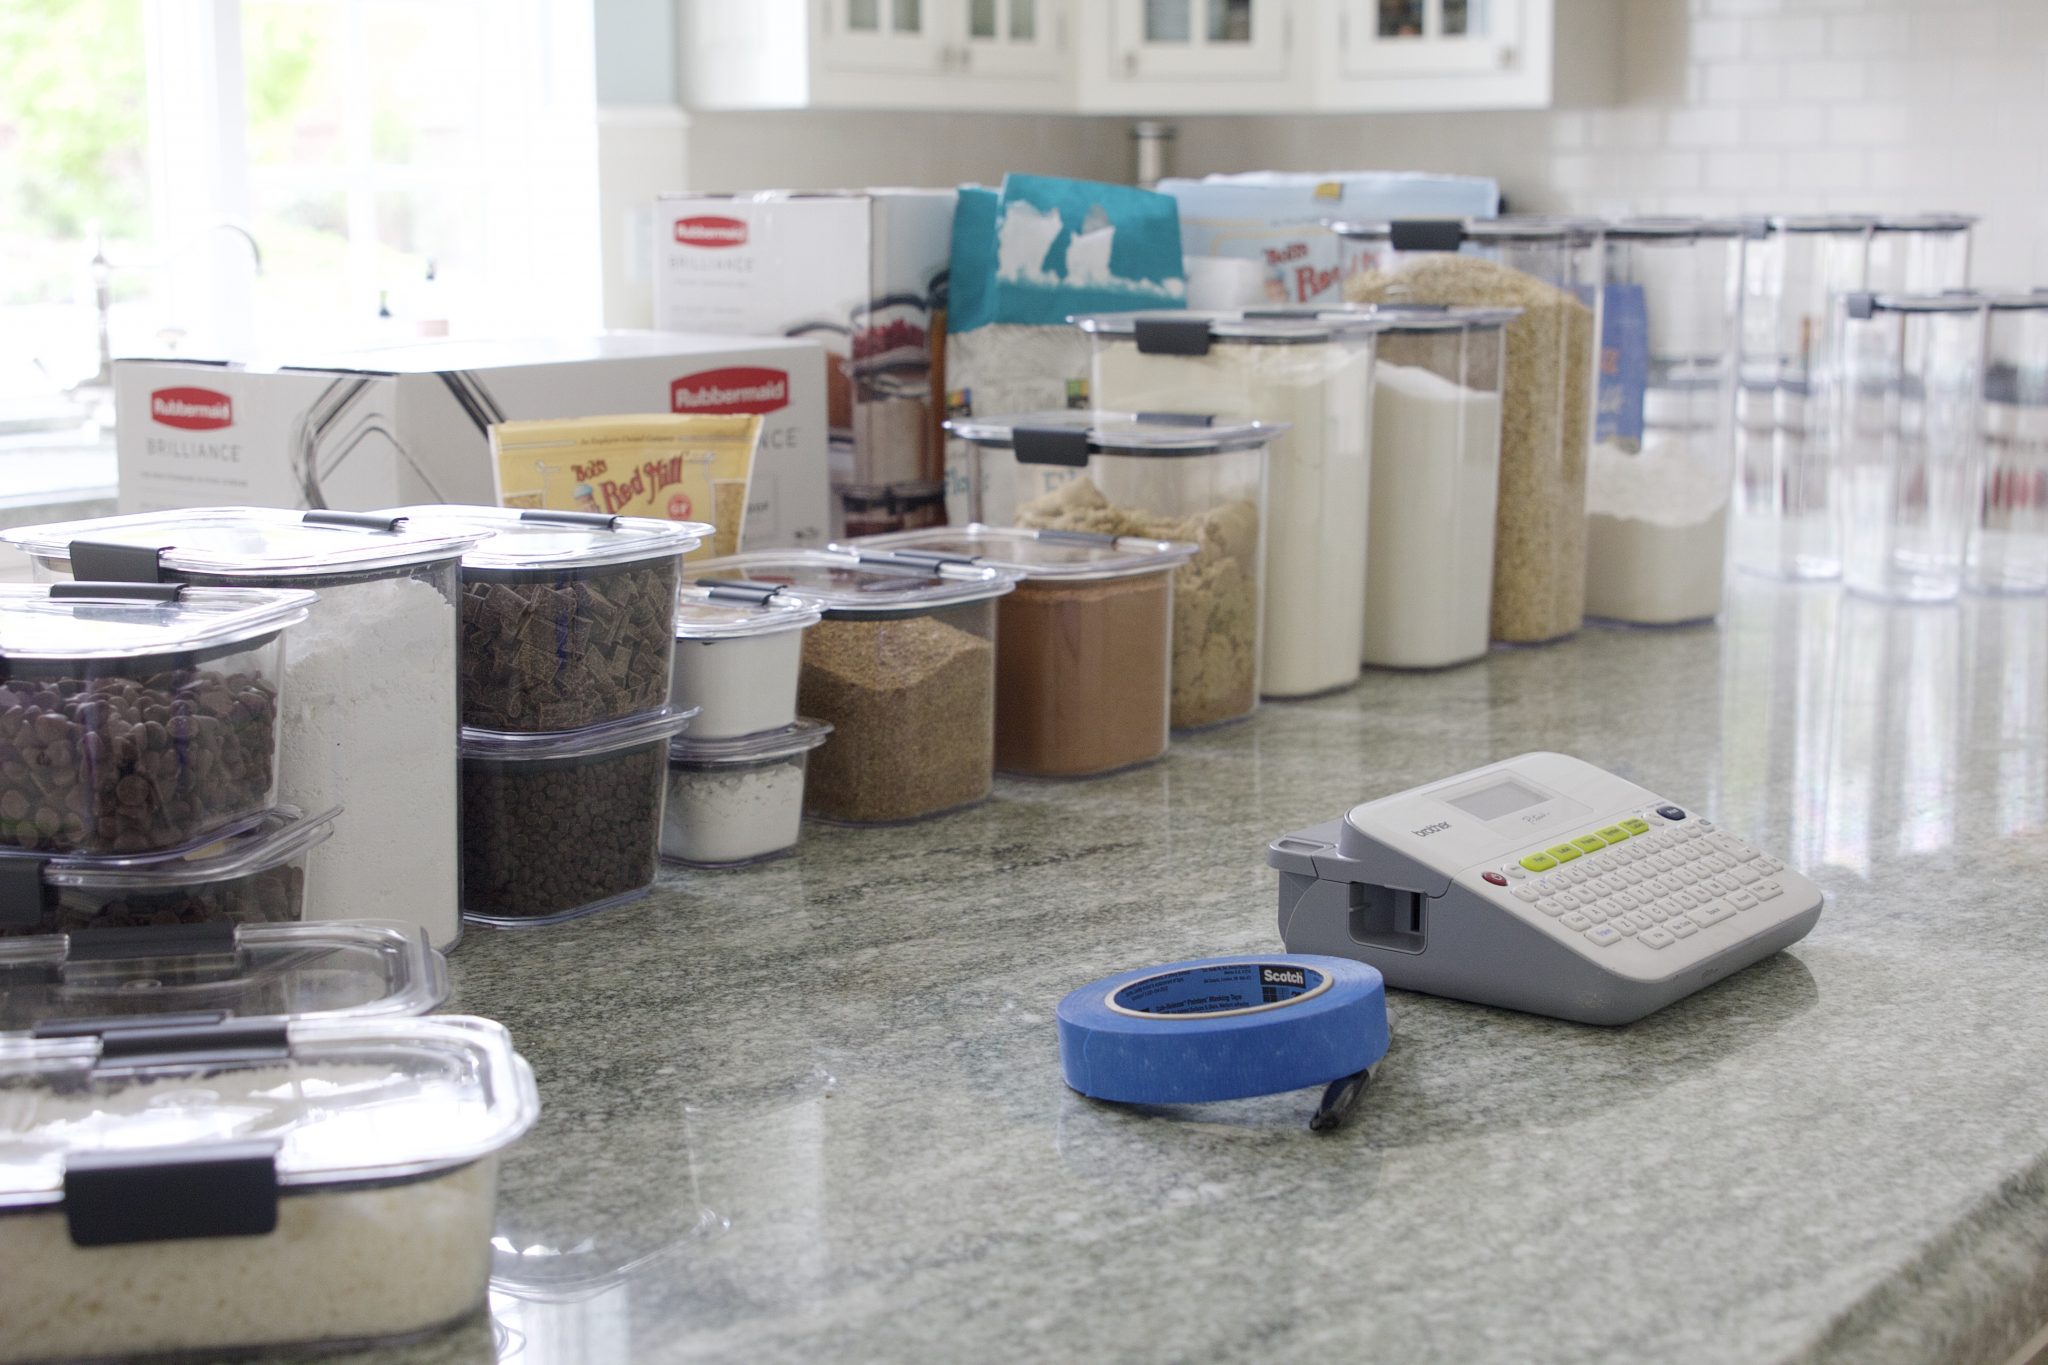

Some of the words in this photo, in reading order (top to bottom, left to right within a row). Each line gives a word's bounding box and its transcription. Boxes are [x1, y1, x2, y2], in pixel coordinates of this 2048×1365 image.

[674, 380, 786, 409] Rubbermaid
[154, 397, 230, 420] Rubbermaid
[599, 465, 645, 515] Red
[643, 453, 683, 505] Mill
[1411, 821, 1453, 838] brother
[1264, 969, 1304, 985] Scotch
